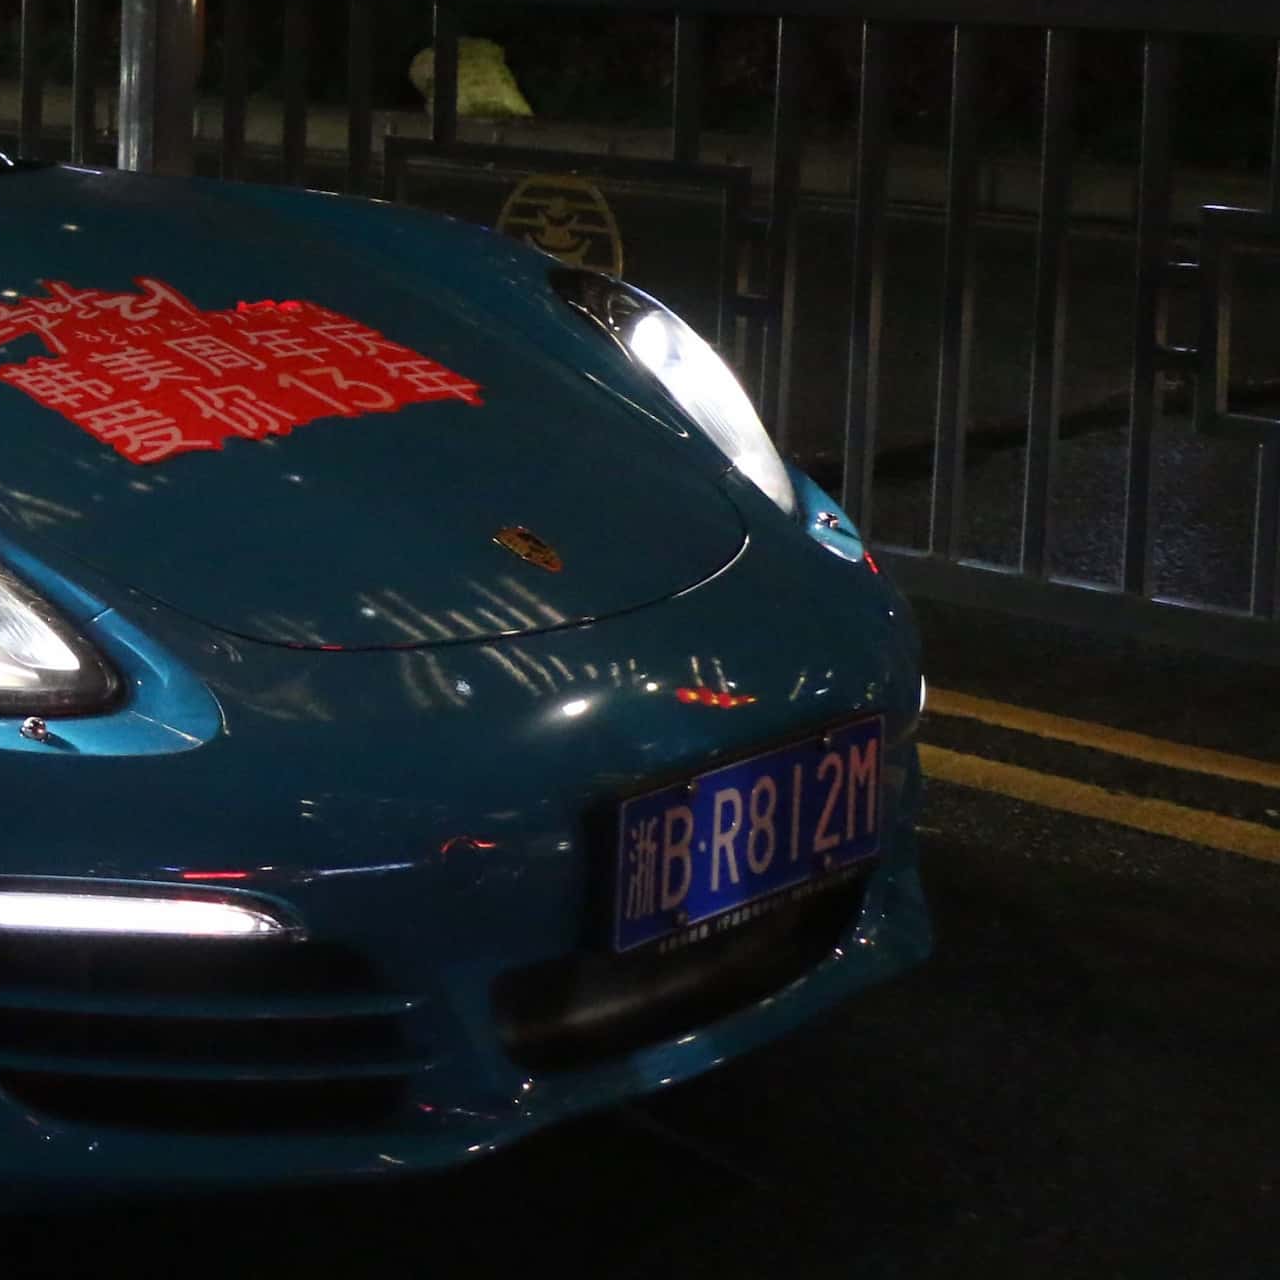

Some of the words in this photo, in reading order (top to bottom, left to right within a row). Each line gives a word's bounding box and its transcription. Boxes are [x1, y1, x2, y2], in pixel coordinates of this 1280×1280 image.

[2, 318, 412, 409] 韩美周年庆
